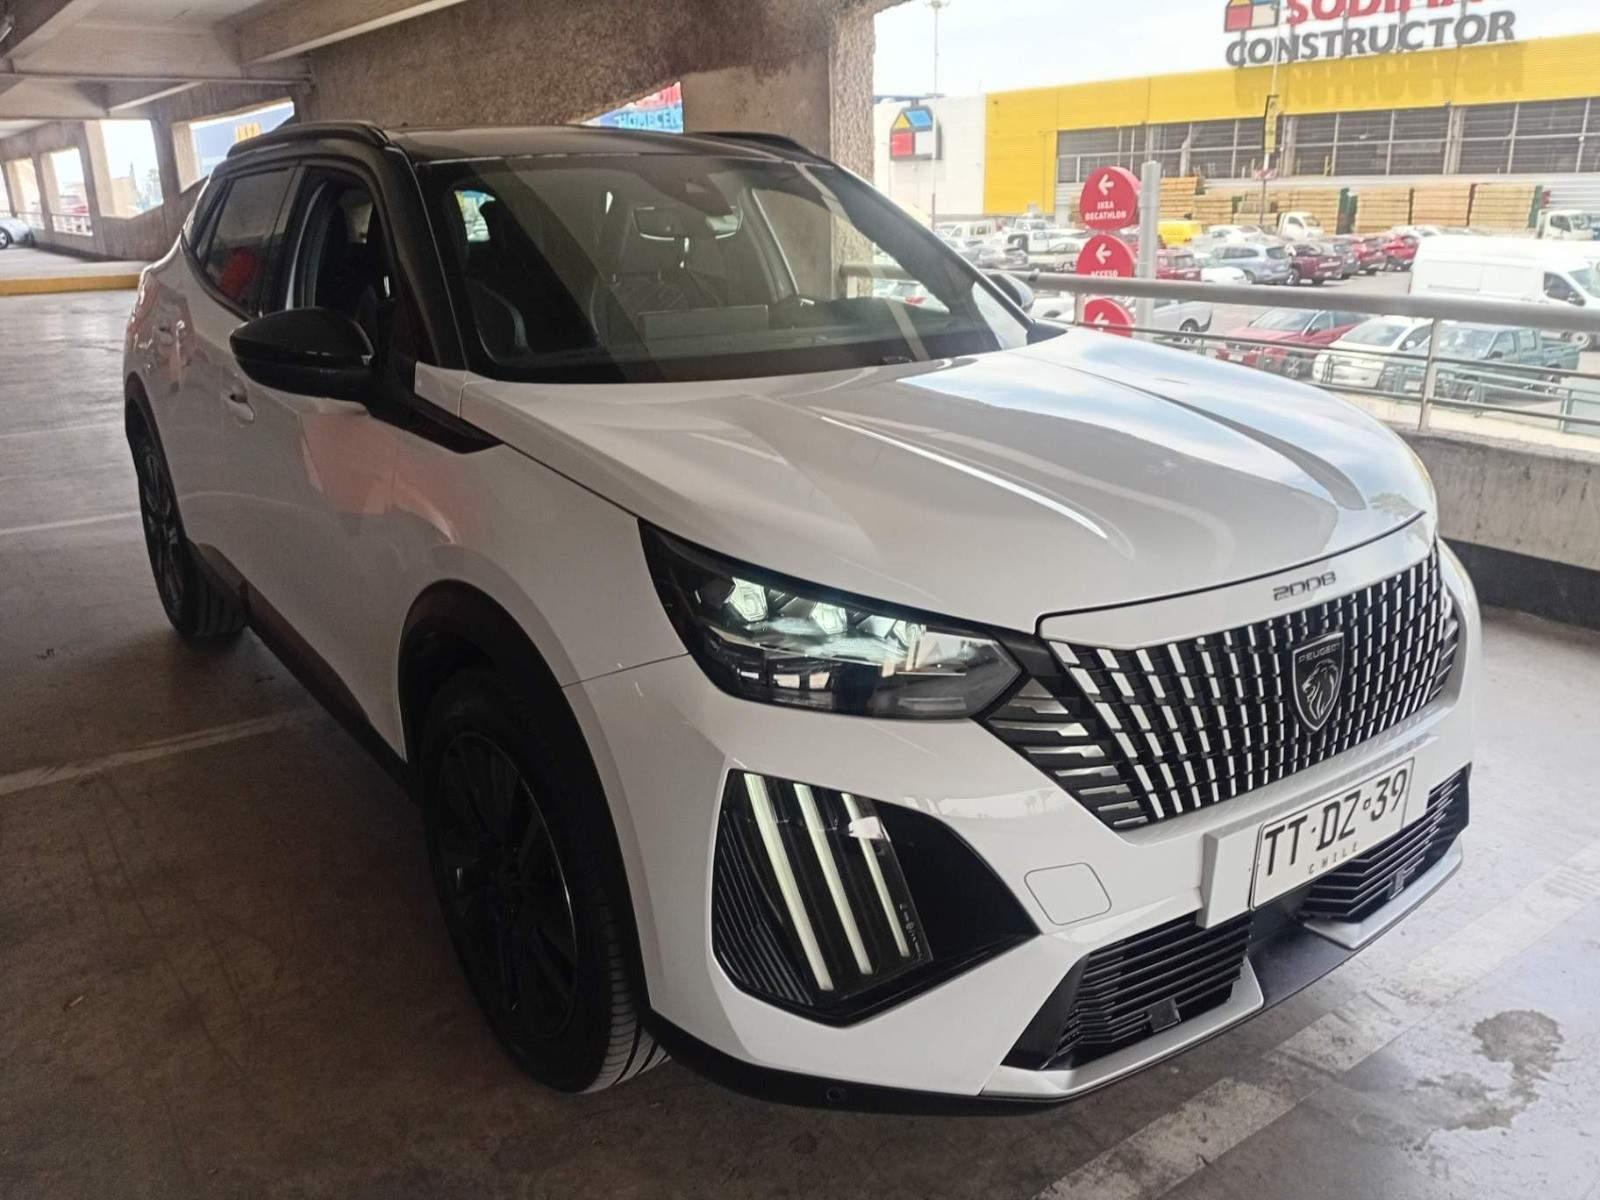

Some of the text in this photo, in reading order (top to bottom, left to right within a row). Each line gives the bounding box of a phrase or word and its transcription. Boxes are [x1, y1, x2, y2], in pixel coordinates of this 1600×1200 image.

[1225, 10, 1516, 67] CONSTRUCTOR
[1085, 210, 1127, 221] DECATHLON
[1272, 571, 1337, 602] 2008
[1298, 642, 1341, 664] PEUGEOT
[1308, 842, 1357, 875] CHILE
